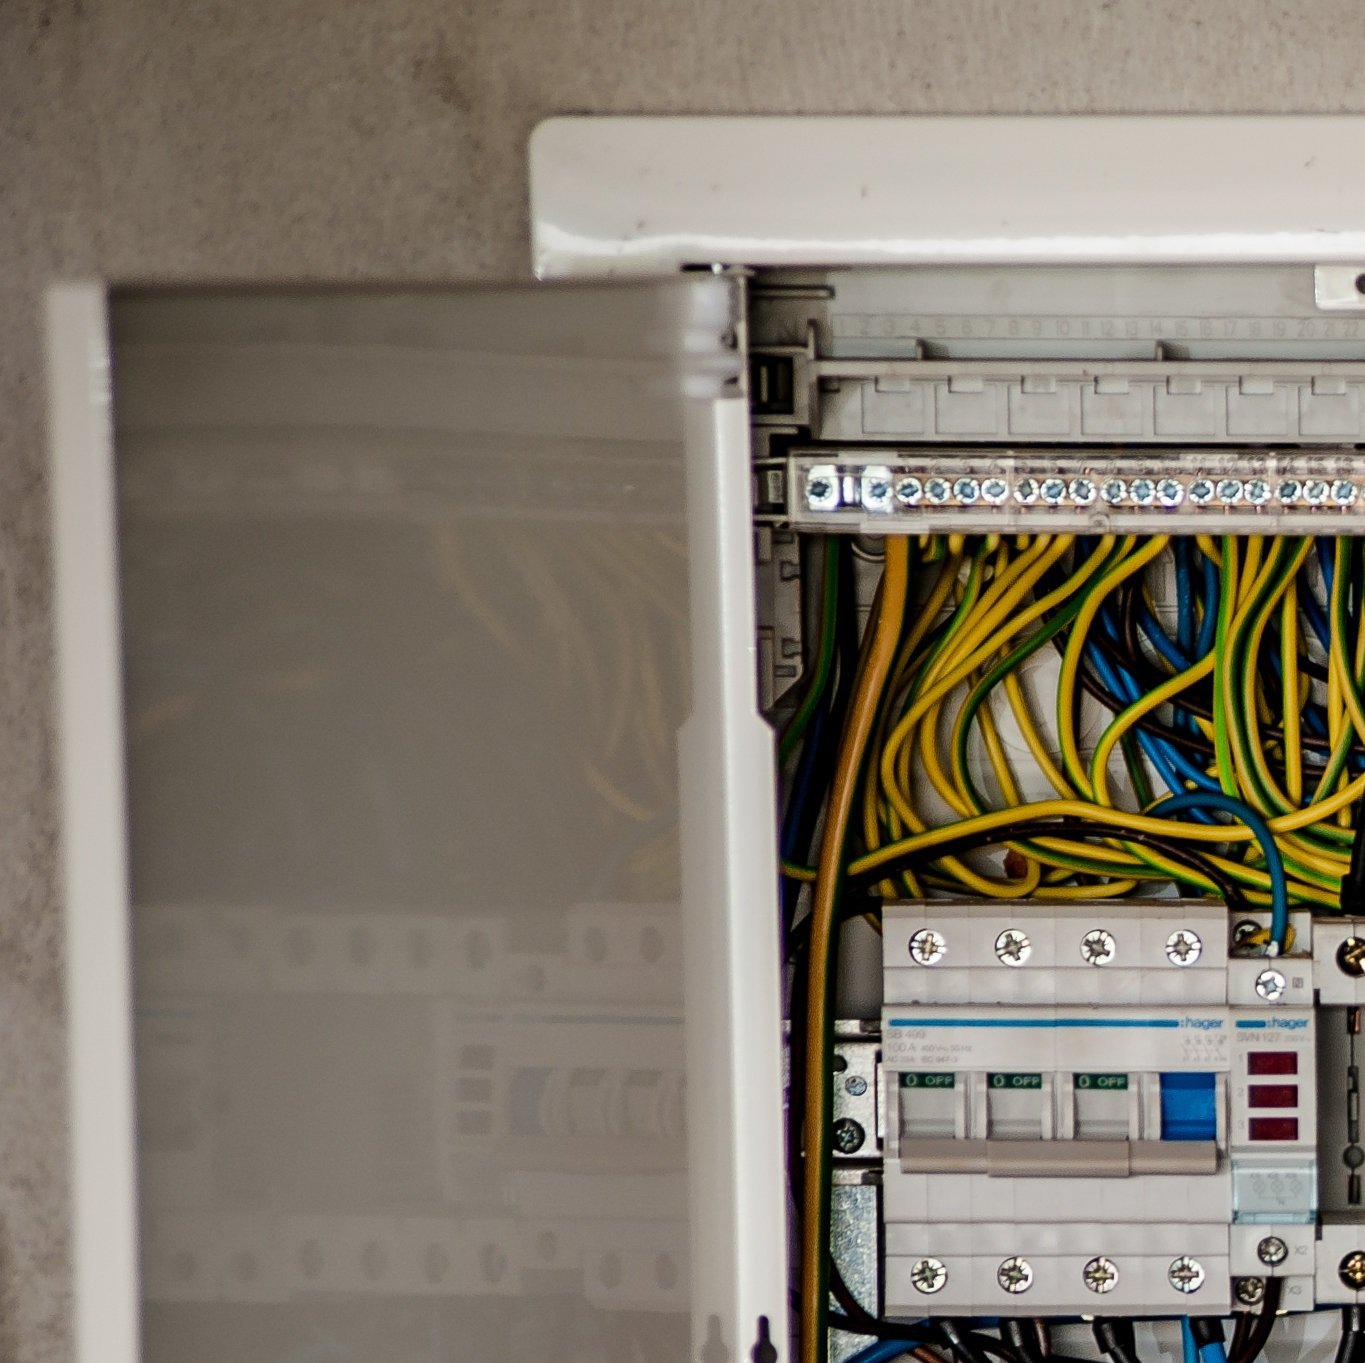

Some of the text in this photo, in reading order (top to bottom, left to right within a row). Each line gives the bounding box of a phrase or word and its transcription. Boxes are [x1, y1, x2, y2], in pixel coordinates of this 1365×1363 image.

[925, 1075, 953, 1086] OFF
[1013, 1075, 1040, 1086] OFF
[1098, 1077, 1126, 1087] OFF
